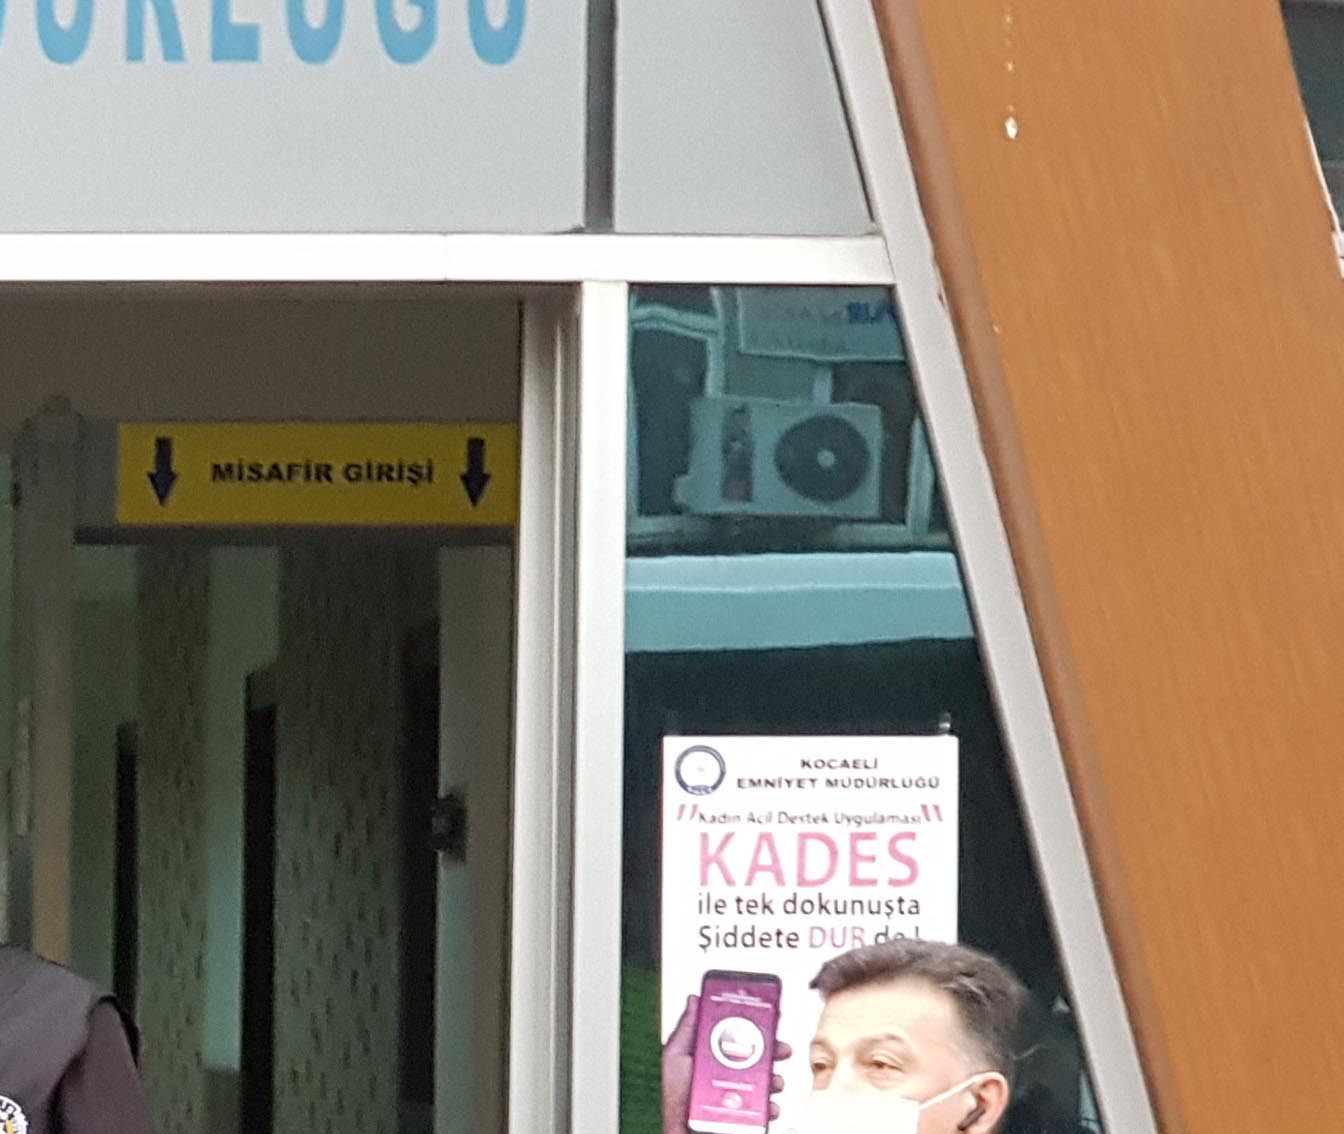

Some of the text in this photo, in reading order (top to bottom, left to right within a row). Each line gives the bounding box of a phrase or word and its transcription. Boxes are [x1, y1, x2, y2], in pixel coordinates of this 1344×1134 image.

[212, 458, 435, 486] MİSAFİR GİRİŞİ
[800, 758, 879, 770] KOCAELİ
[736, 776, 940, 791] EMNİYET MÜDÜRLÜĞÜ
[699, 831, 920, 887] KADES
[698, 893, 921, 919] ile tek dokunuşta
[699, 926, 799, 953] Şiddete
[808, 926, 866, 949] DUR
